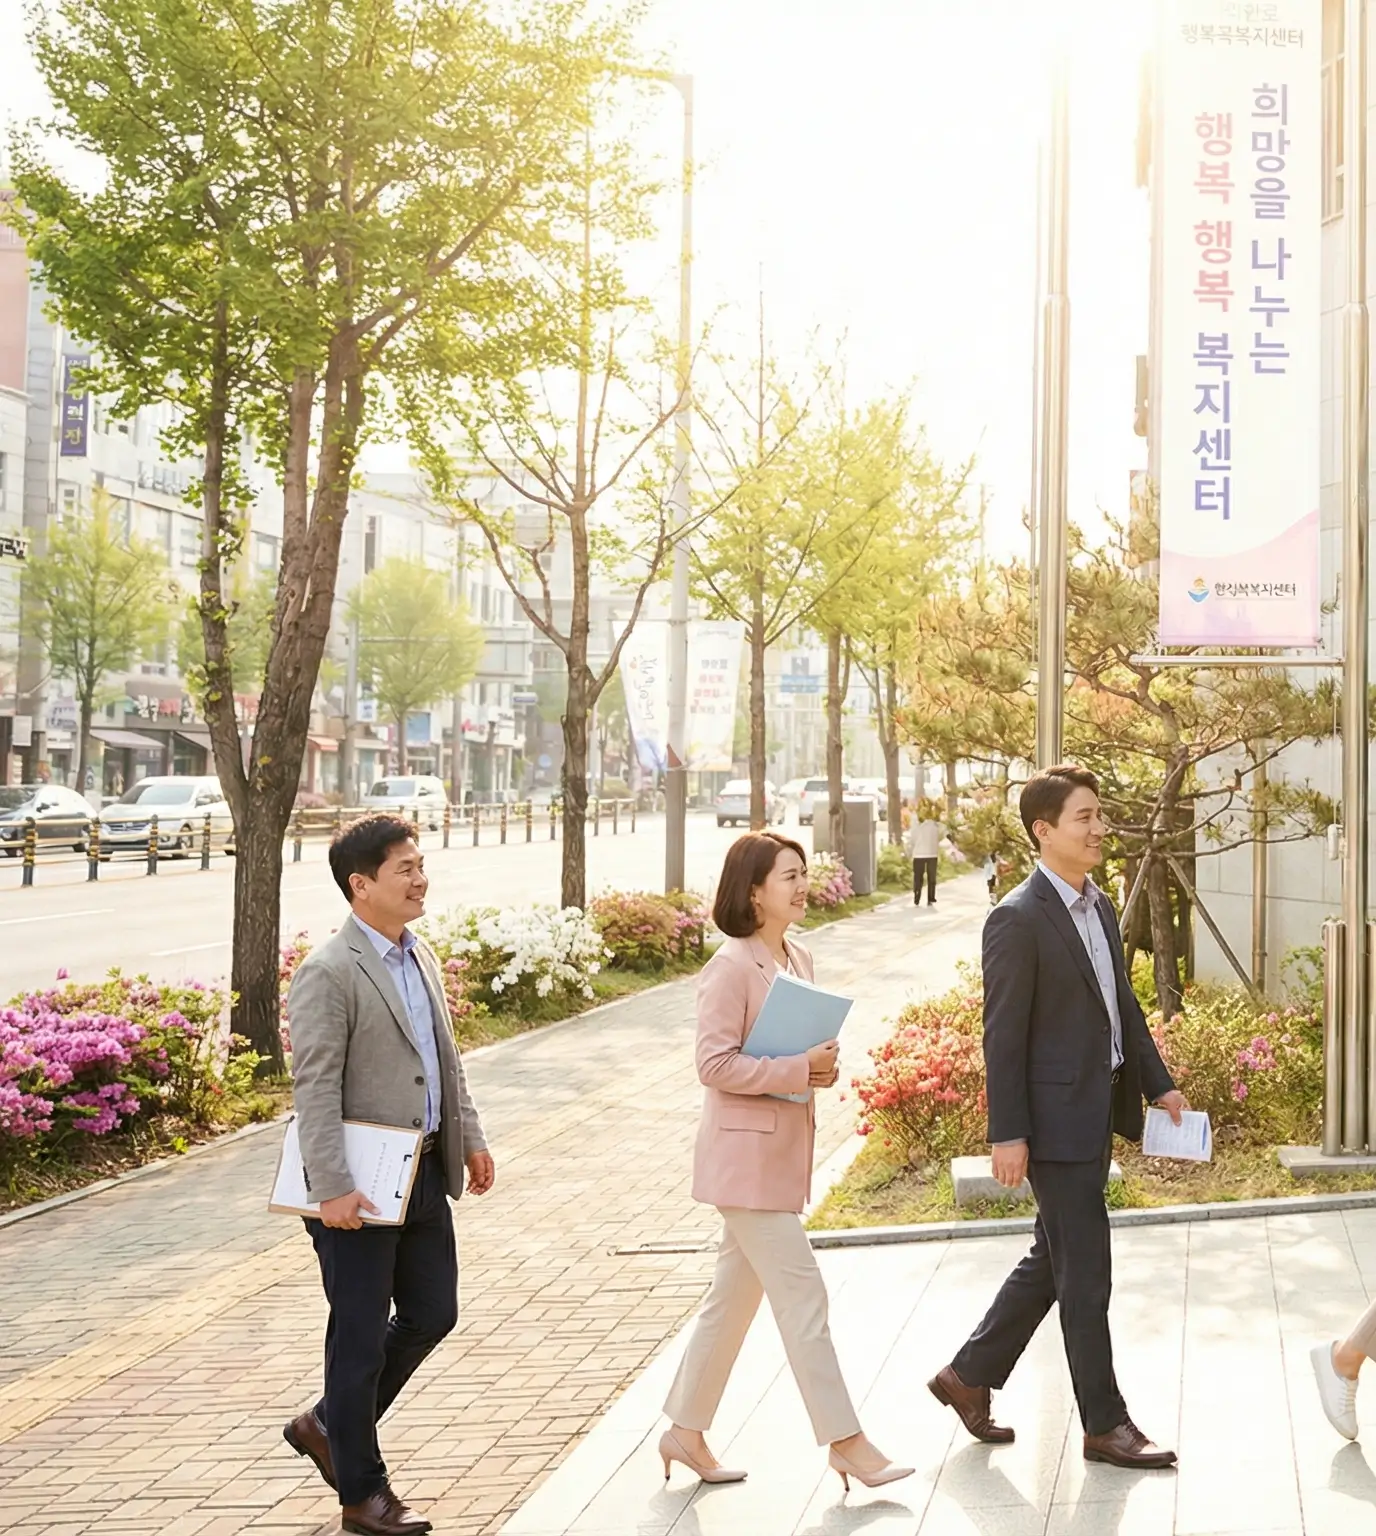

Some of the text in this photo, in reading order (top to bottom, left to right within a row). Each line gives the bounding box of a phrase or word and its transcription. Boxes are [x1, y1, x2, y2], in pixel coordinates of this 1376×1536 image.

[1192, 111, 1235, 520] 행복 행복 복지센터
[1249, 82, 1292, 375] 희망을 나누는
